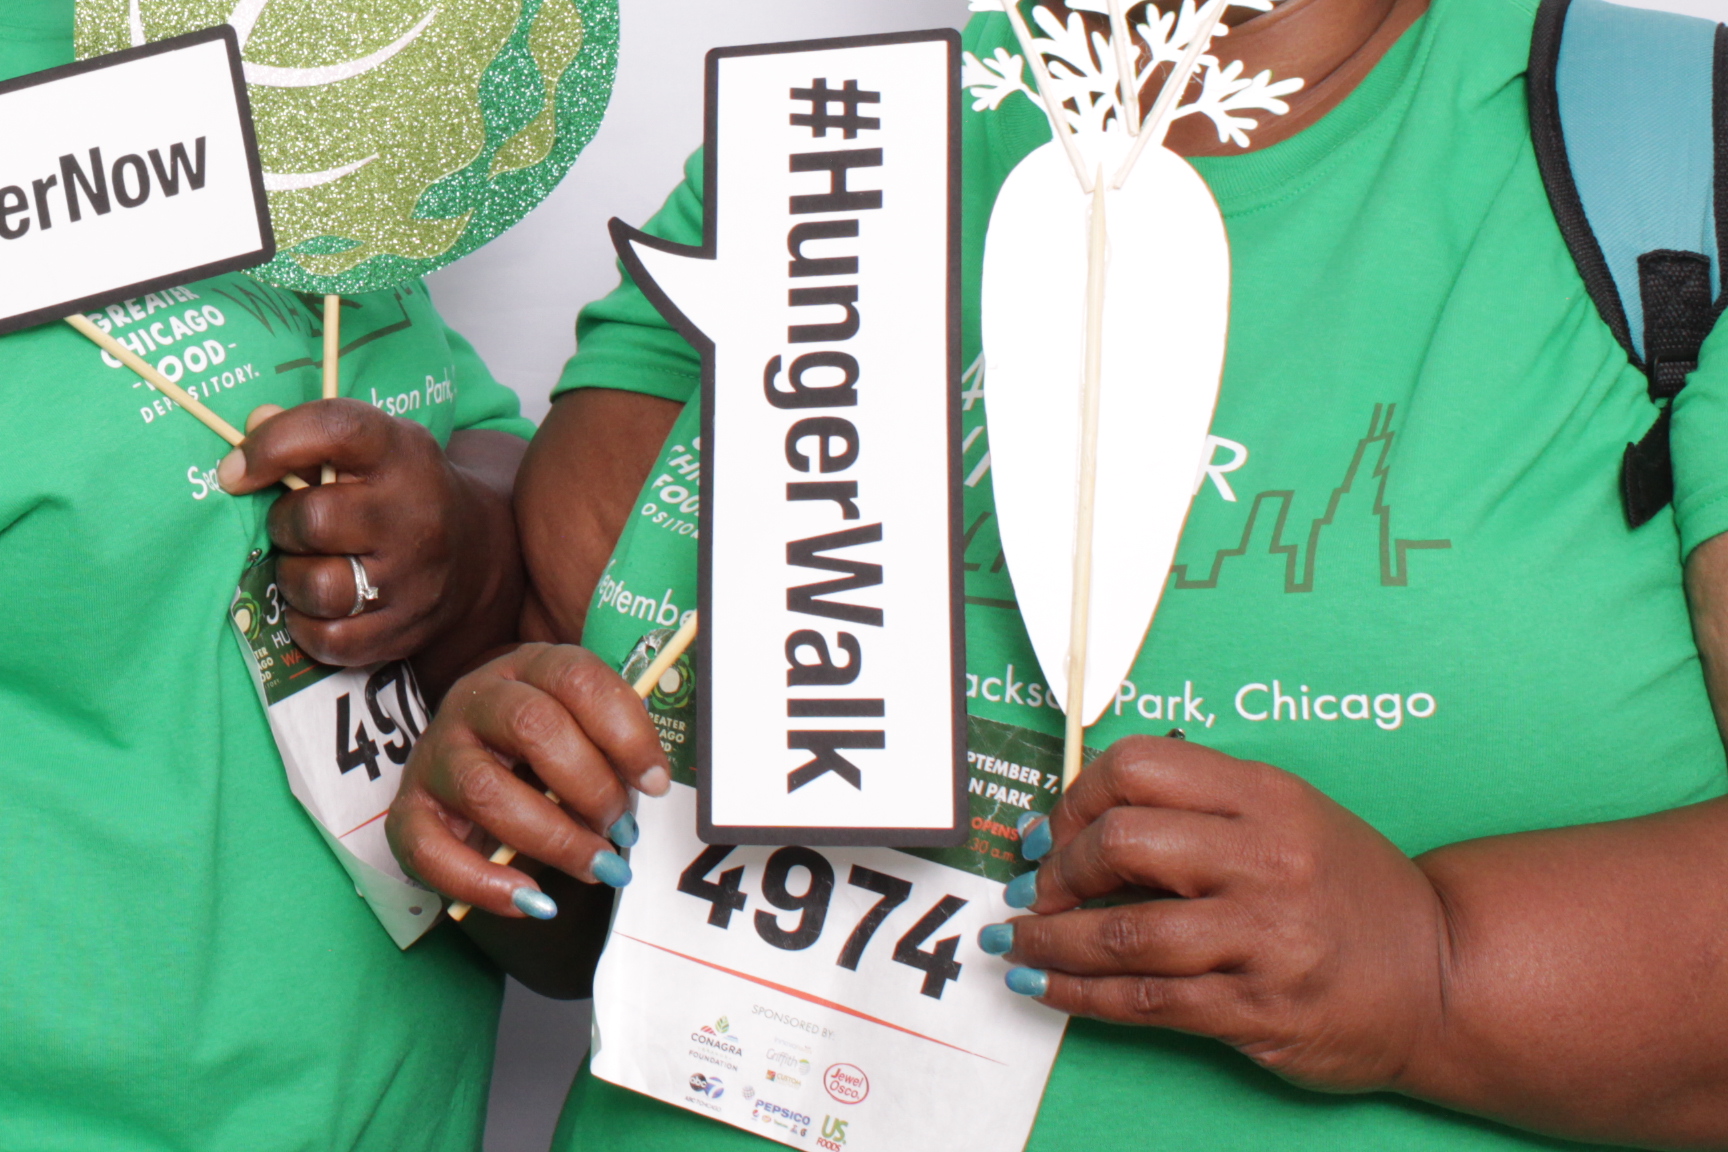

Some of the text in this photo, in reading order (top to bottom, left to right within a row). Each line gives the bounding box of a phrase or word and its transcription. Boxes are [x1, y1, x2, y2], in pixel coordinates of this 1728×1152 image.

[140, 363, 260, 424] DEPSITORY.
[370, 387, 420, 417] kson
[763, 76, 886, 795] #HungerWalk
[965, 663, 1437, 731] ackso Park, Chicago
[967, 751, 1042, 787] PTEMBER
[1043, 773, 1060, 794] 7,
[985, 783, 1035, 811] PARK
[971, 817, 1020, 842] OPENS
[677, 844, 970, 1000] 4974
[751, 1004, 820, 1035] SPONSORED
[690, 1033, 743, 1057] CONAGRA
[688, 1049, 739, 1073] FOUNDATION
[830, 1067, 864, 1088] Jewel
[755, 1099, 811, 1127] PEPSICO
